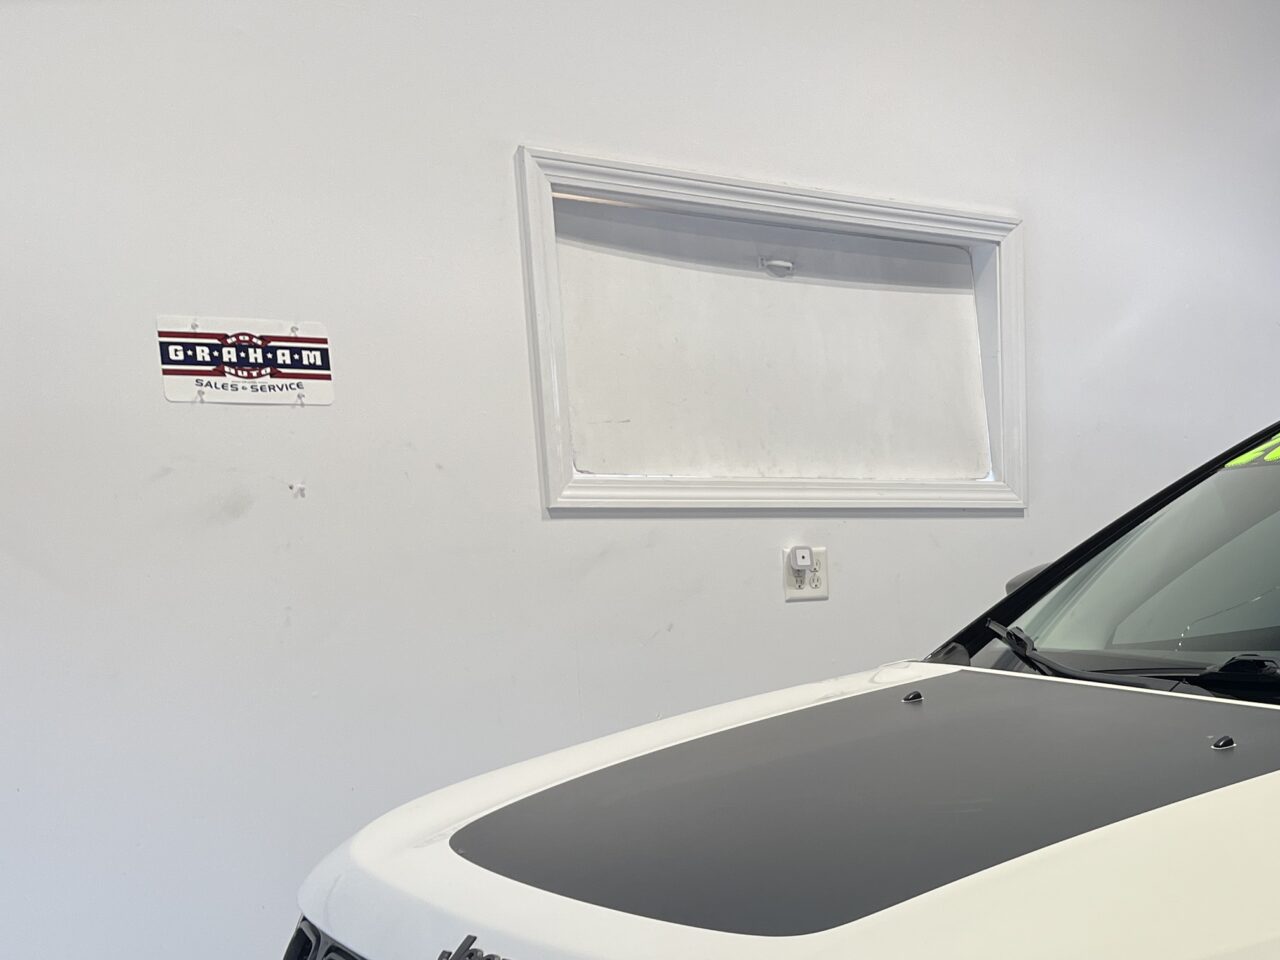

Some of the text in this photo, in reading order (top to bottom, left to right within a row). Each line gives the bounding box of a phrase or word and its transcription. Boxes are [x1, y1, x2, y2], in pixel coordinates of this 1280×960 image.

[224, 366, 271, 377] AUTO
[195, 379, 239, 392] SALES
[250, 382, 305, 392] SERVICE
